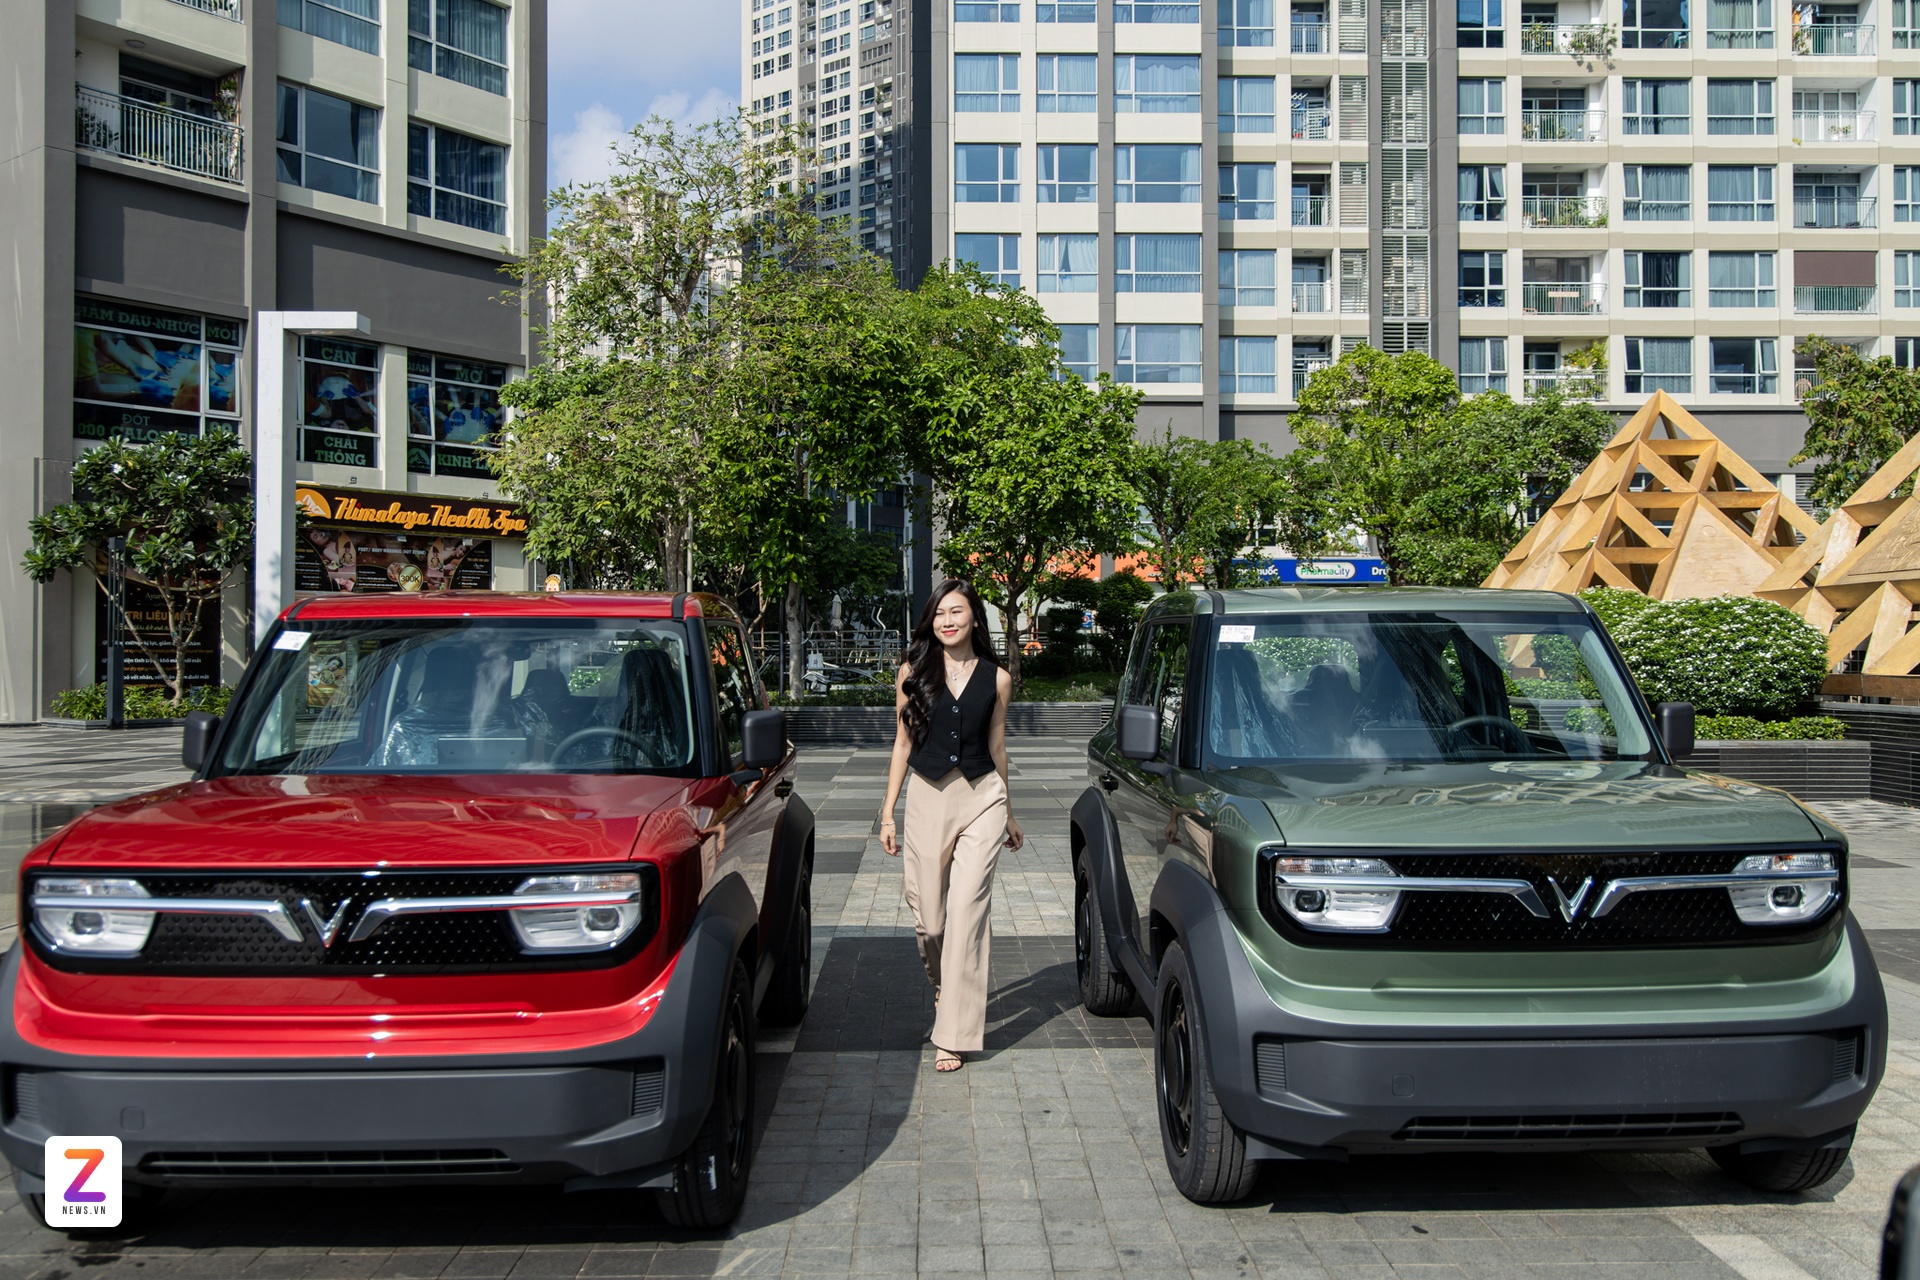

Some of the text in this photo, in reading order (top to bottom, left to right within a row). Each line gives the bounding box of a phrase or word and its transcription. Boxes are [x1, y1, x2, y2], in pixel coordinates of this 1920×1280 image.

[321, 345, 357, 365] CÂN
[110, 424, 199, 446] CALOES
[323, 435, 359, 450] CHẢI
[314, 449, 367, 466] THÔNG
[436, 453, 473, 469] KINH
[334, 496, 528, 536] Himalaya Health Spa
[400, 574, 420, 583] 300K
[1300, 564, 1351, 577] Pharmacity
[127, 610, 143, 622] TRỊ
[145, 609, 168, 622] LIỆU
